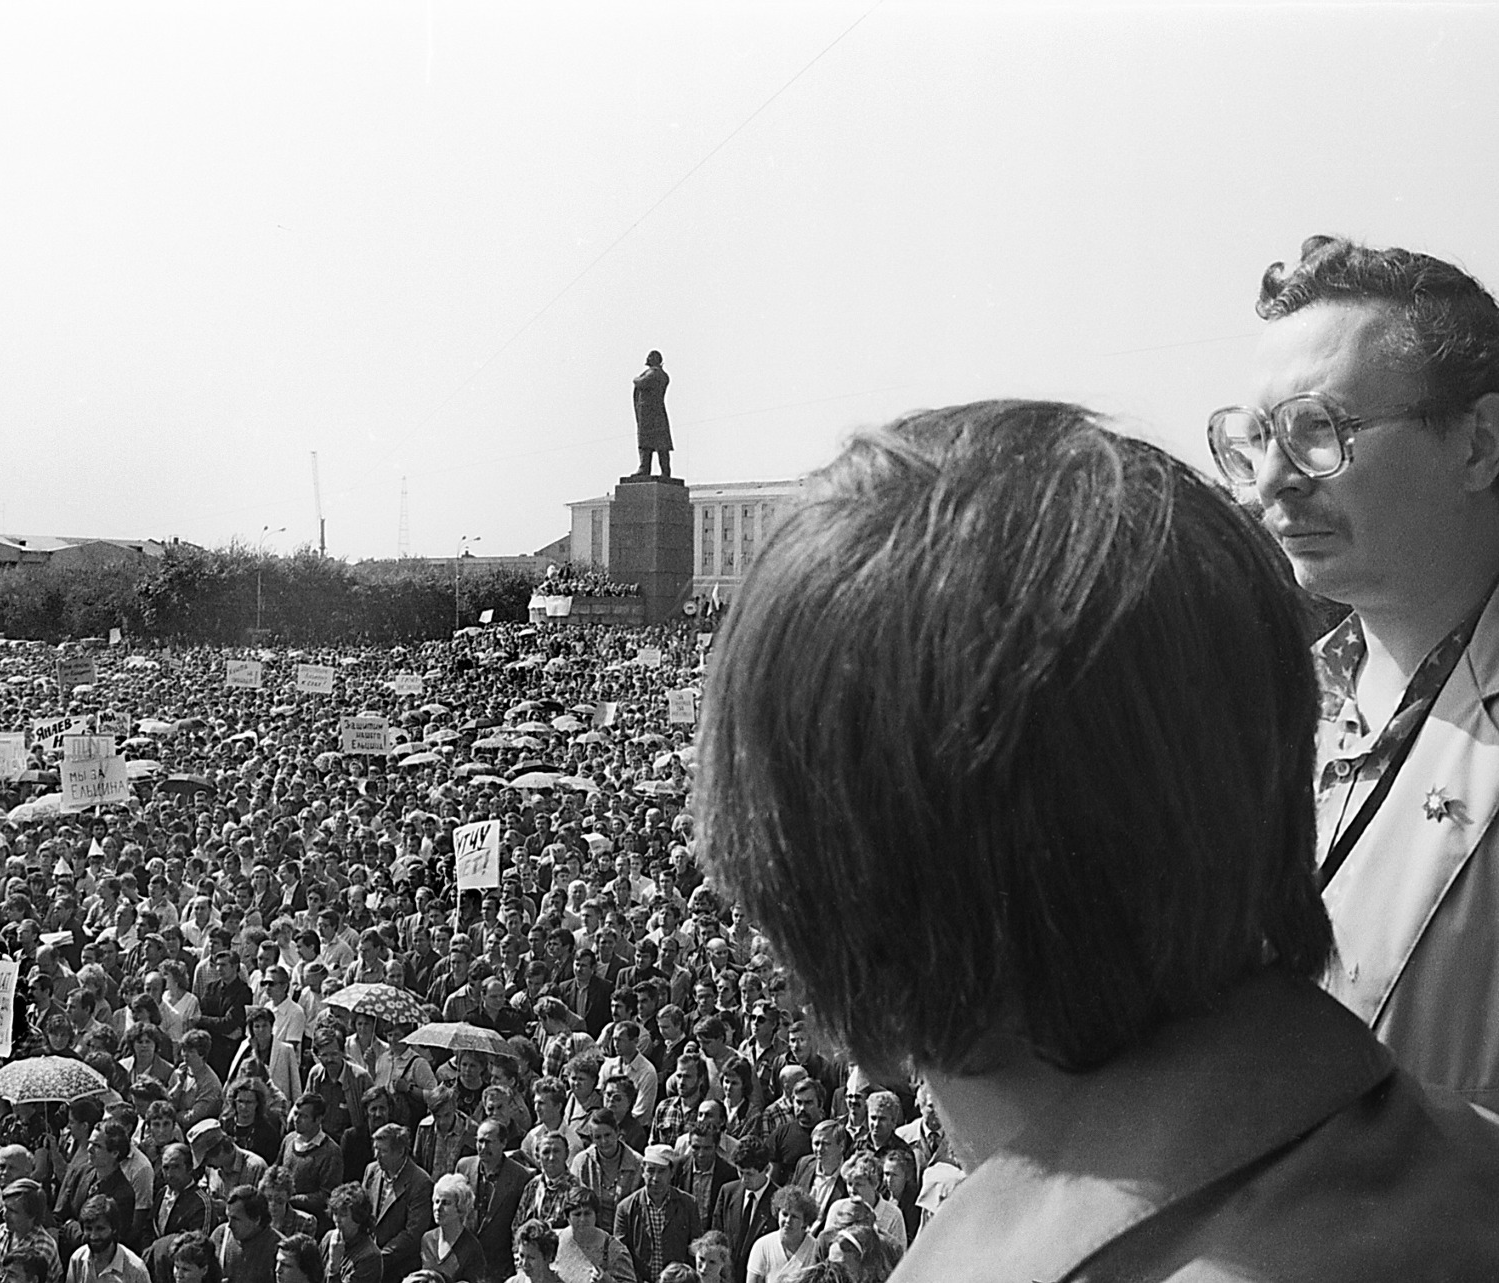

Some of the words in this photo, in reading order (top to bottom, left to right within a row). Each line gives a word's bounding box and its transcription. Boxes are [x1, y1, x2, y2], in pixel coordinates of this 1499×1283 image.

[99, 712, 116, 723] МЫ
[69, 771, 87, 782] МЫ
[91, 769, 105, 780] ЗА
[71, 780, 126, 799] ЕЛЬЦИНА
